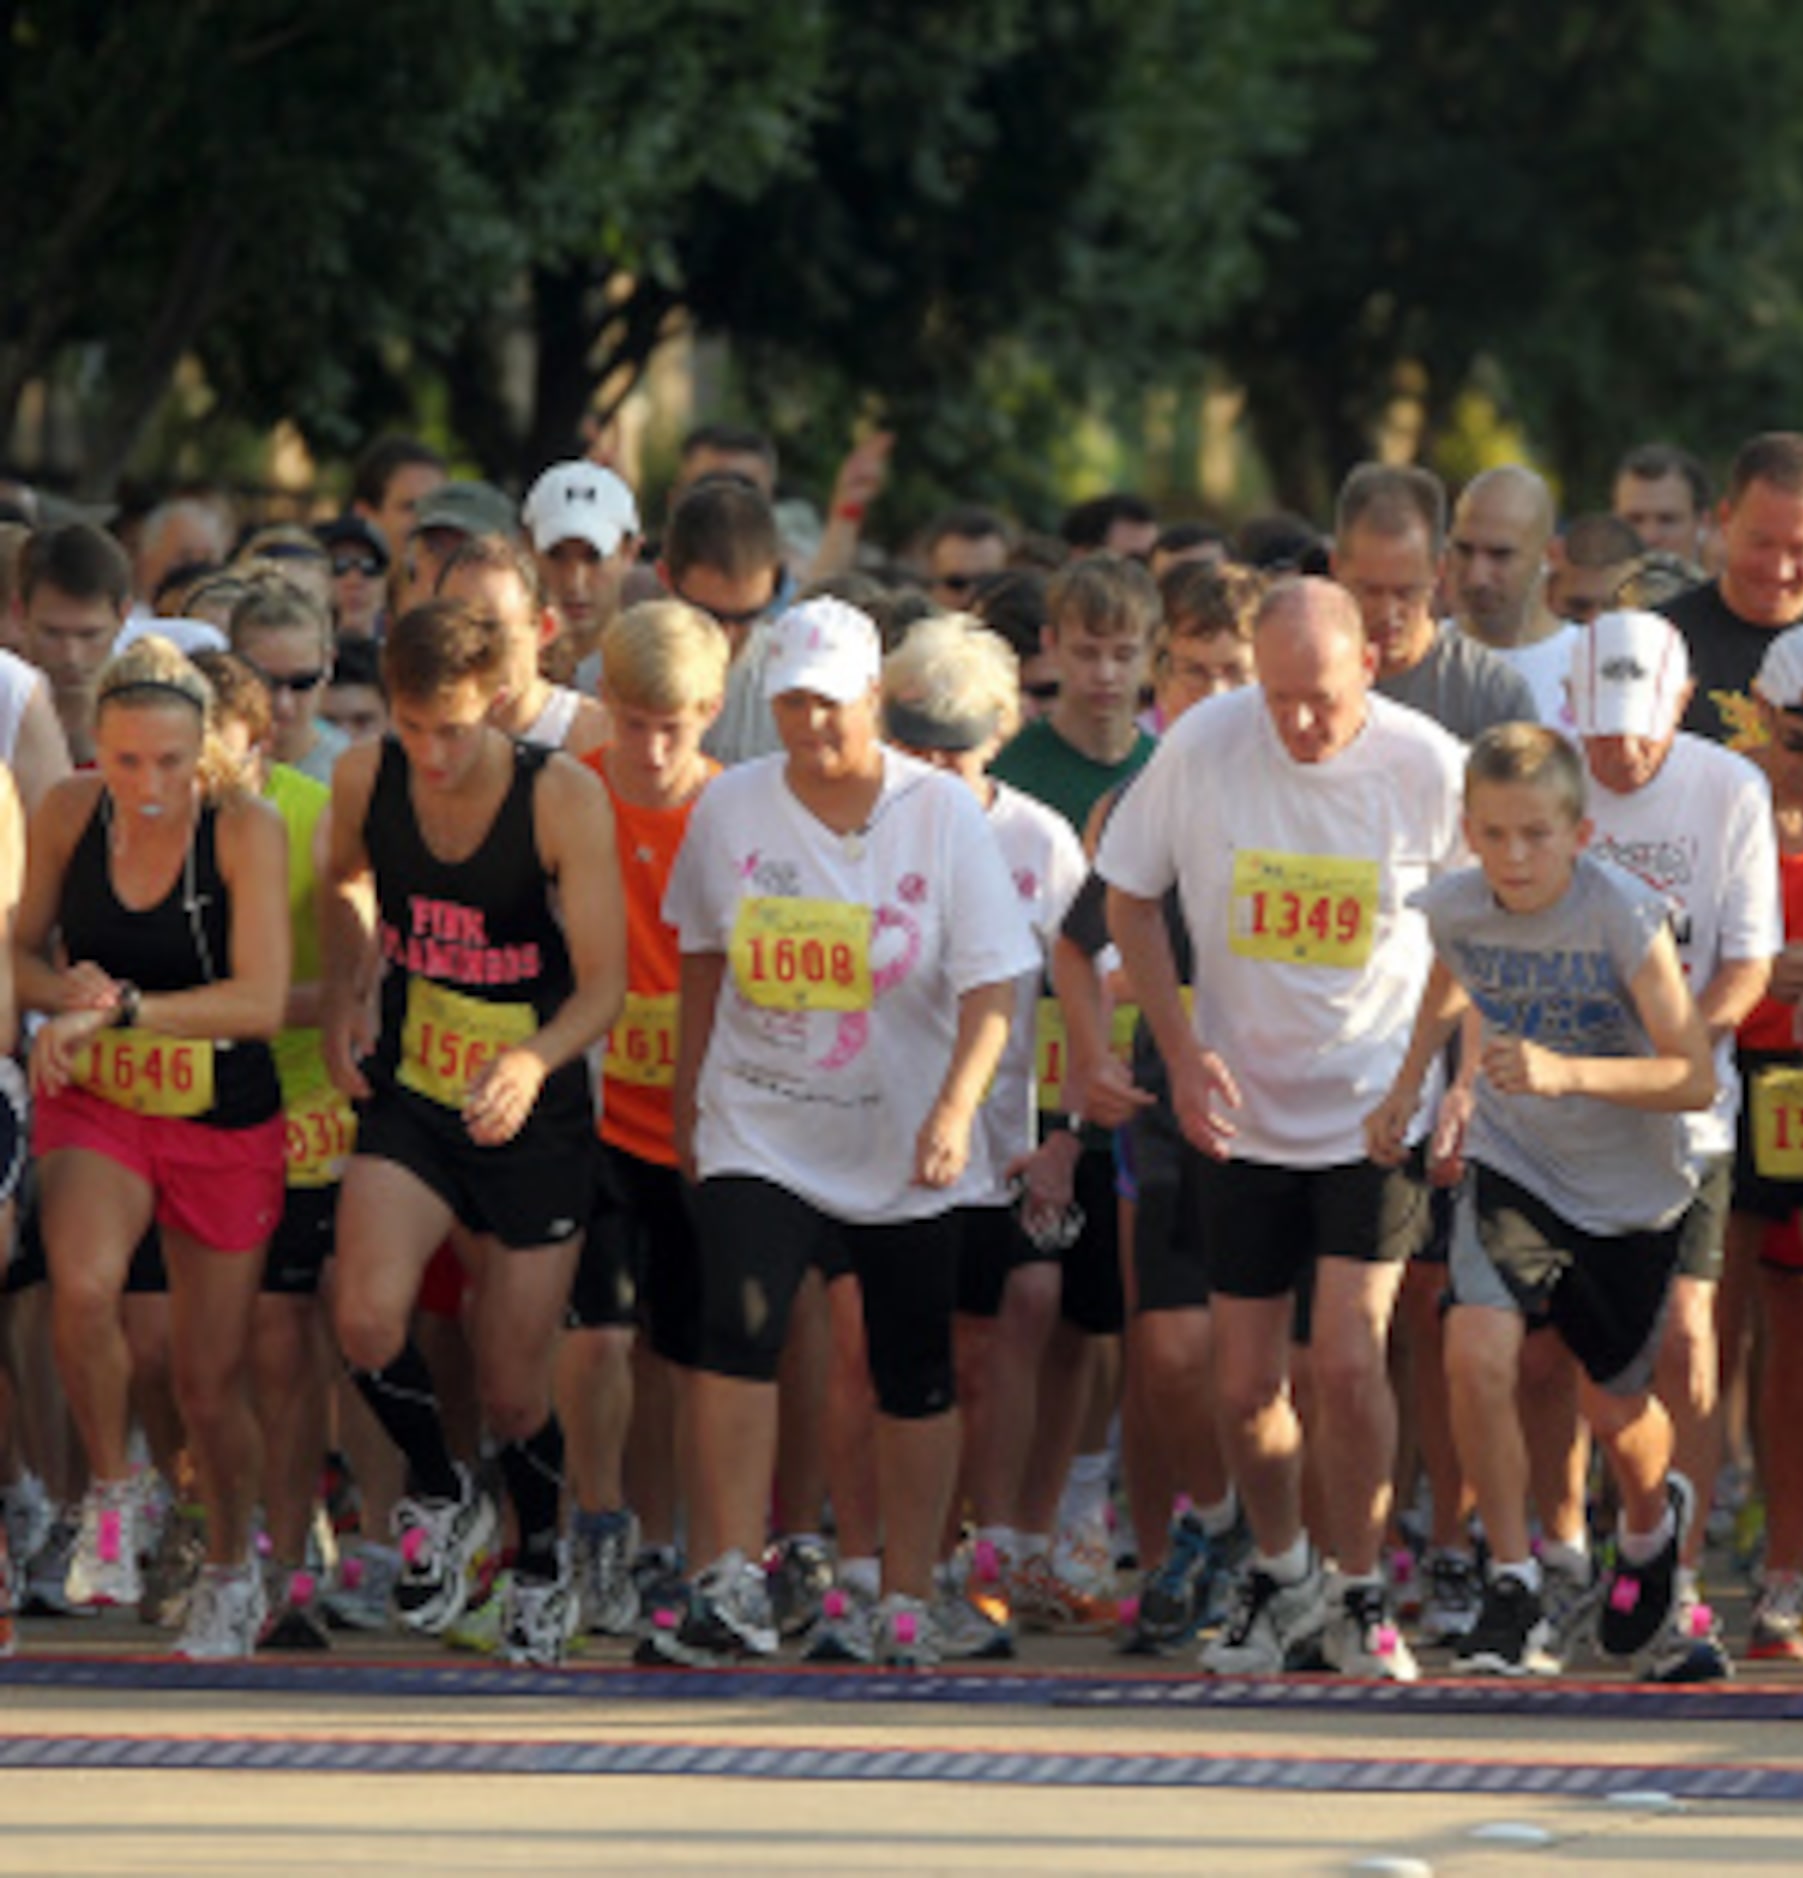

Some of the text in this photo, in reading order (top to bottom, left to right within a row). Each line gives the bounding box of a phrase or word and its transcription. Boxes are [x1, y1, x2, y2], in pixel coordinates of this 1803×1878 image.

[1252, 890, 1361, 944] 1349
[748, 938, 855, 987] 1608
[90, 1041, 193, 1093] 1646
[418, 1022, 510, 1082] 156
